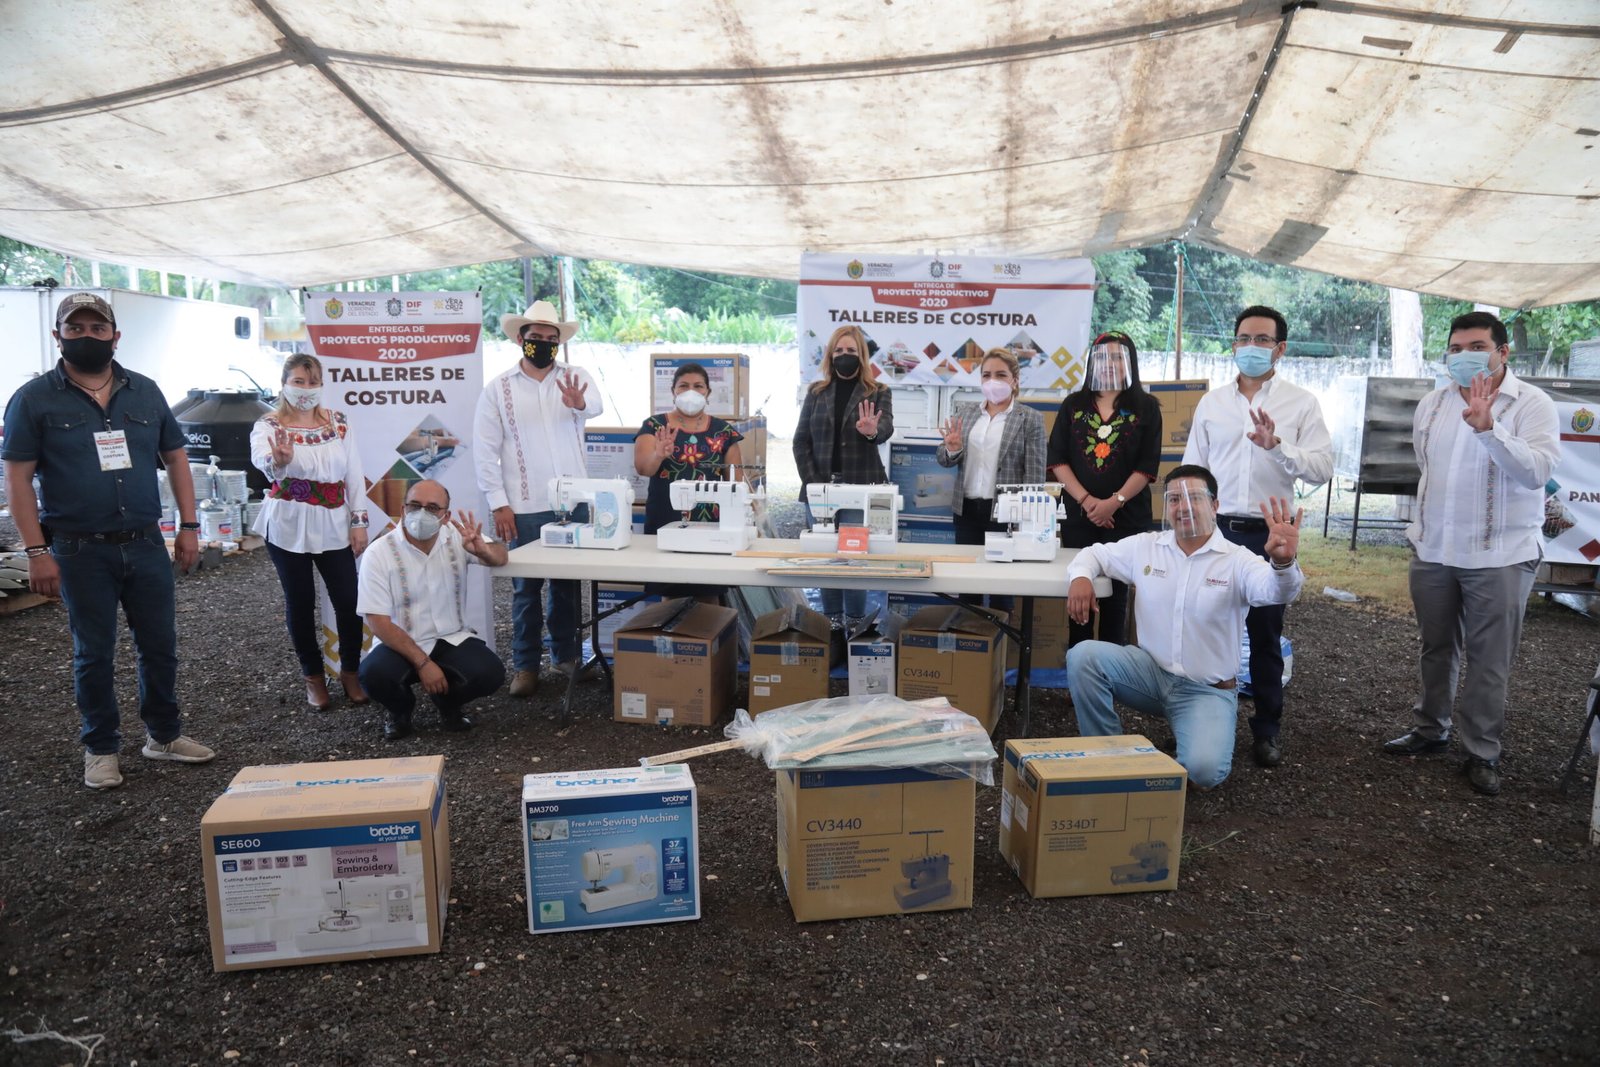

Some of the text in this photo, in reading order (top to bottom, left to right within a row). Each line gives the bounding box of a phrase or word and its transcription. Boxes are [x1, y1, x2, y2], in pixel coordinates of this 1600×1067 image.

[928, 289, 989, 297] PRODUCTIVOS
[919, 298, 948, 308] 2020
[828, 309, 1037, 327] TALLERES DE COSTURA
[368, 325, 425, 333] ENTREGA DE
[319, 334, 471, 345] PROYECTOS PRODUCTIVOS
[378, 348, 417, 360] 2020
[328, 366, 465, 383] TALLERES DE
[344, 389, 446, 406] COSTURA
[677, 643, 704, 651] brother
[959, 640, 983, 648] brother
[903, 667, 941, 680] CV3440
[295, 776, 385, 787] brother
[555, 777, 639, 787] brother
[1145, 778, 1177, 787] brother
[661, 795, 689, 804] brother
[529, 805, 560, 815] BM3700
[571, 812, 680, 829] Free Arm Sewing Machine
[806, 818, 862, 833] CV3440
[1051, 818, 1098, 831] 3534DT
[369, 825, 416, 837] brother
[221, 838, 261, 850] SE600
[669, 840, 680, 848] 37
[336, 856, 370, 865] Sewing
[669, 856, 681, 864] 74
[337, 863, 394, 874] Embroidery
